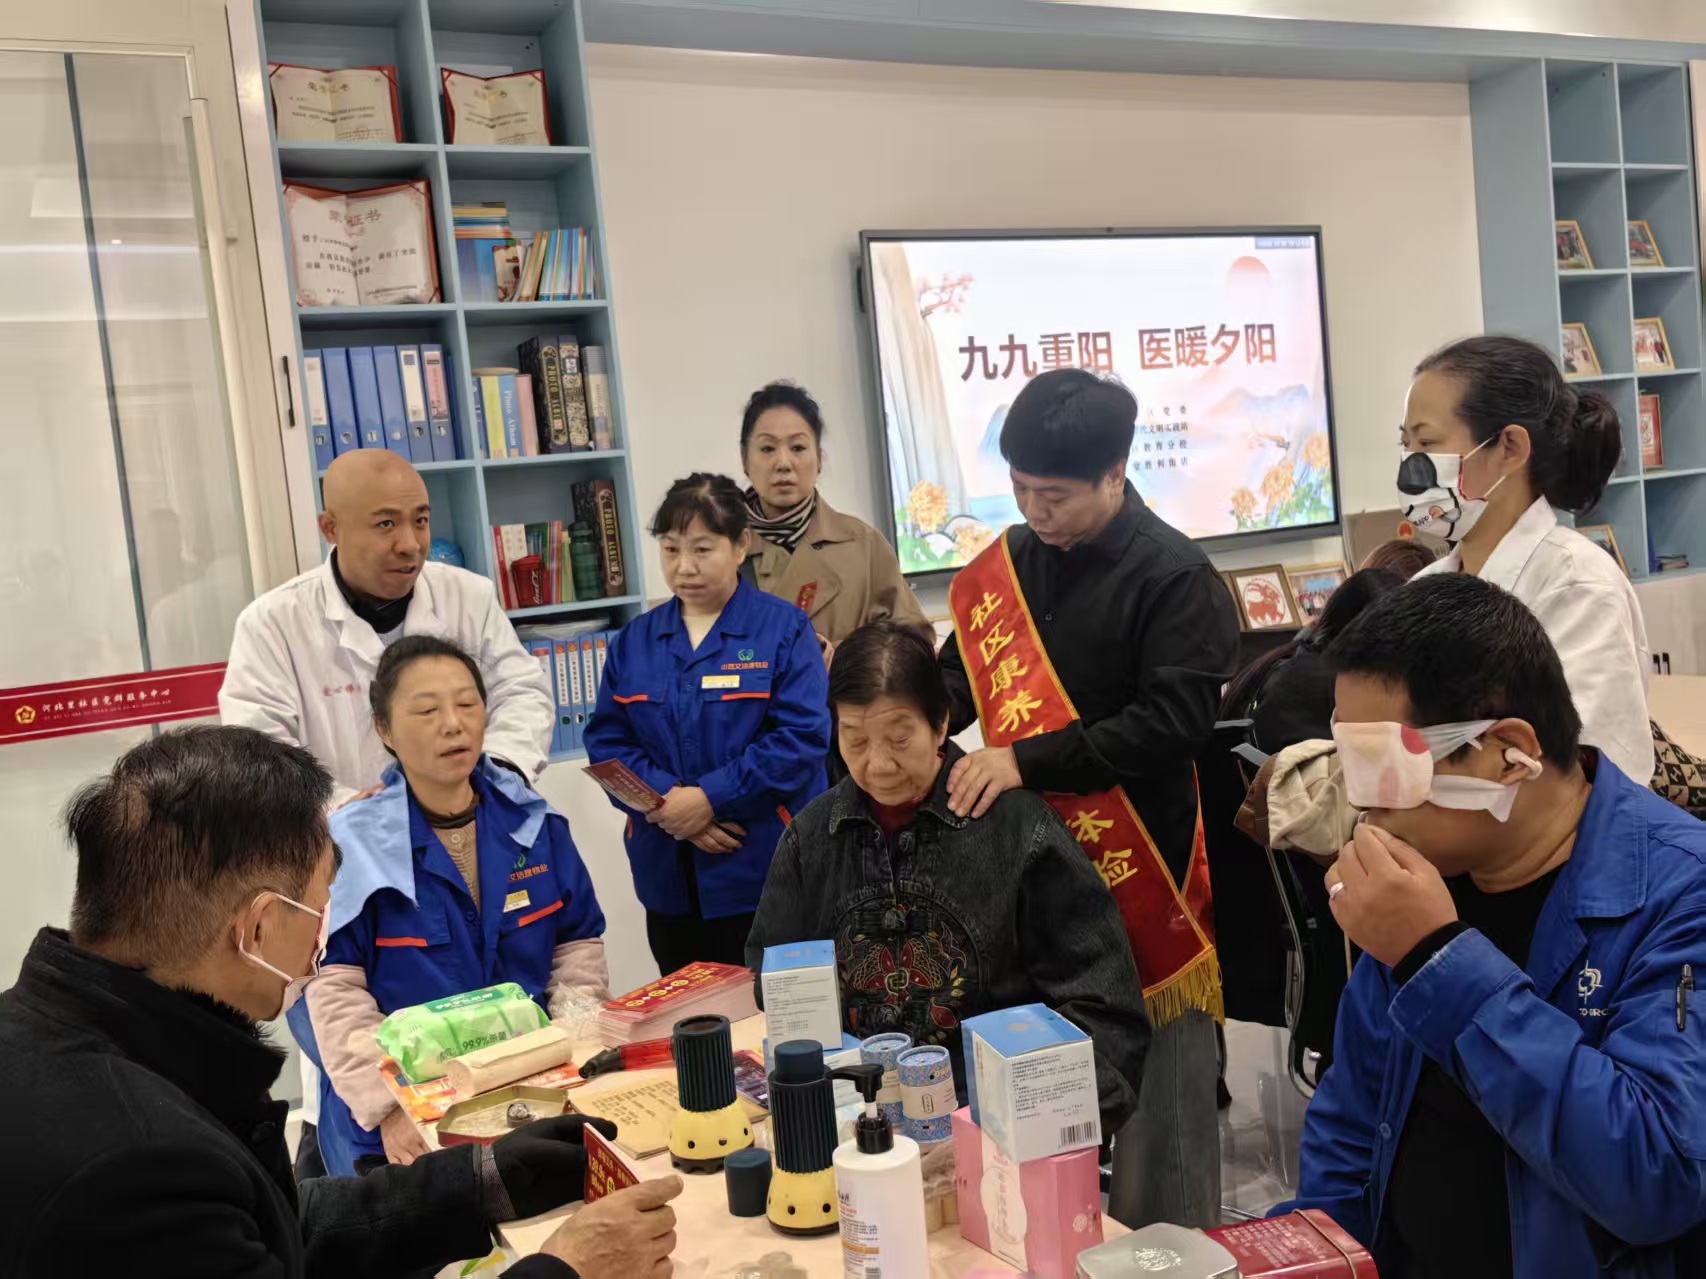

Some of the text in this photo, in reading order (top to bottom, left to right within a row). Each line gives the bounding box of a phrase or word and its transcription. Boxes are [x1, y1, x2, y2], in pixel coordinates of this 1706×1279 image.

[958, 323, 1276, 381] 九九重阳 医暖夕阳
[969, 591, 1044, 736] 社区康养
